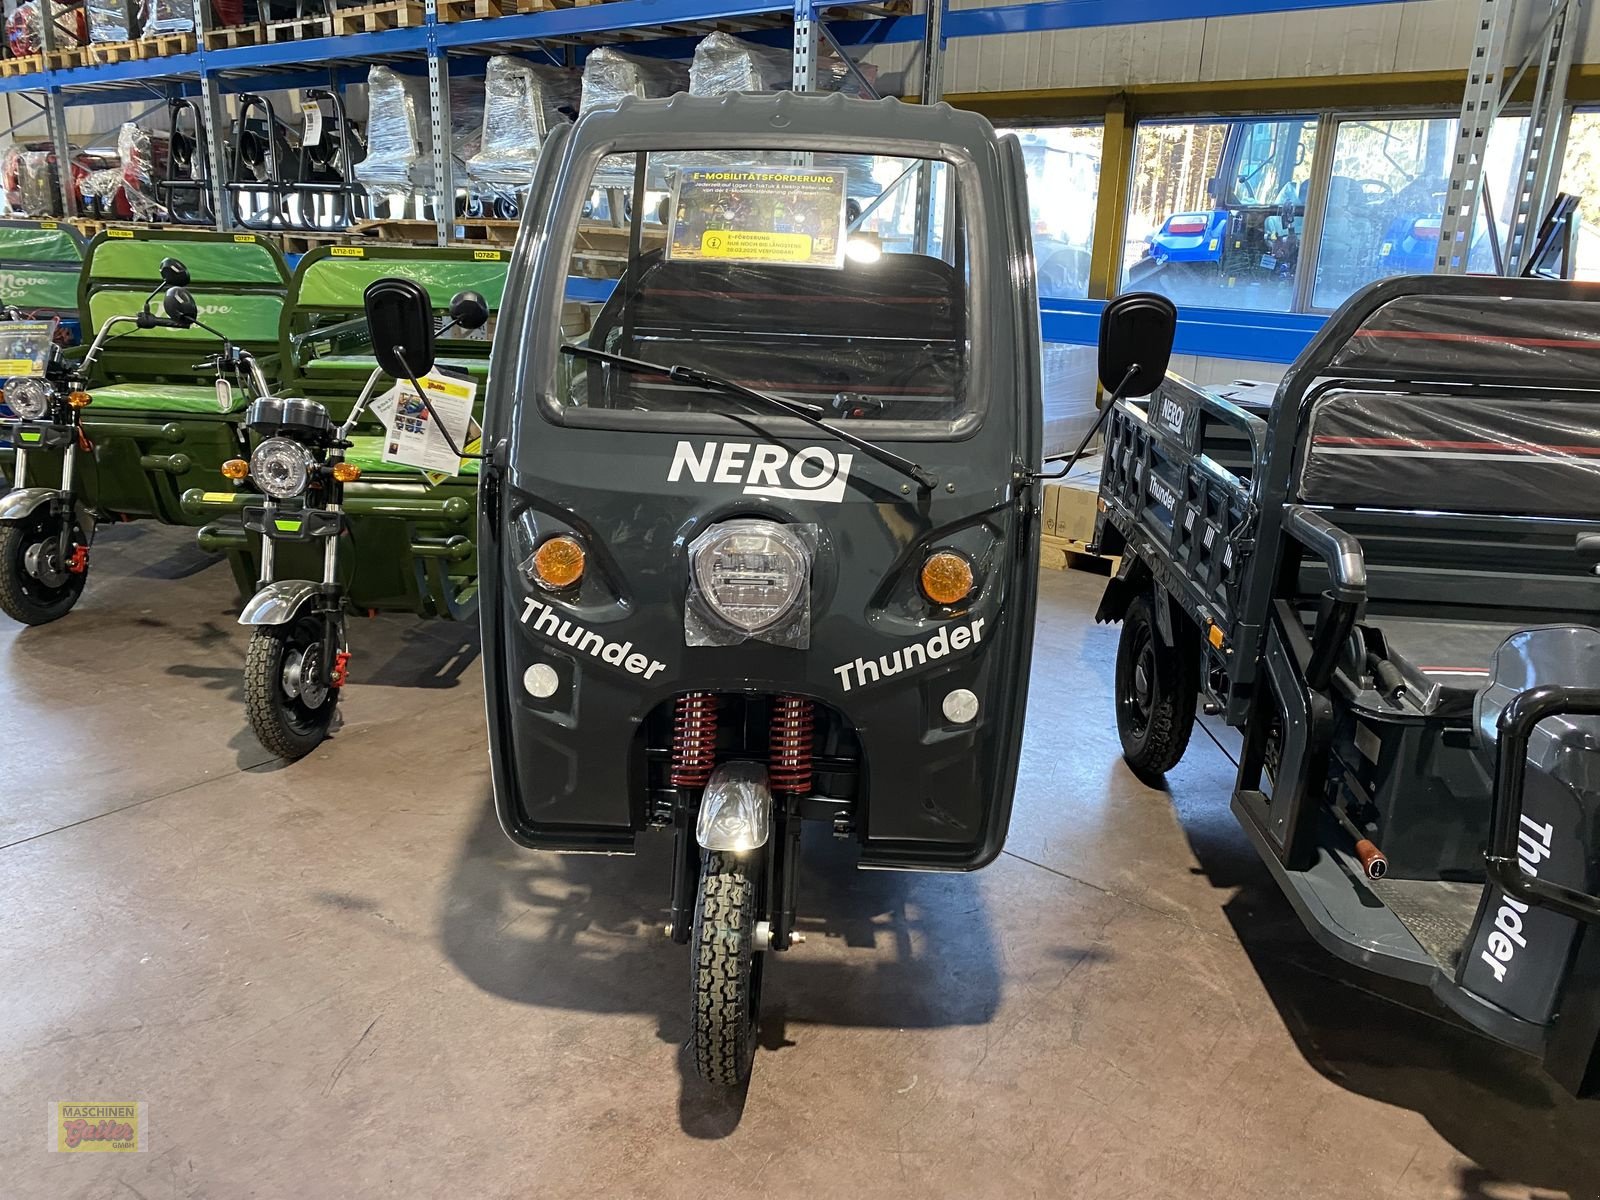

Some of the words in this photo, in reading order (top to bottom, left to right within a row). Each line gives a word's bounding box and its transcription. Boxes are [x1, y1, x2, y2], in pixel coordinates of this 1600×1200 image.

[693, 172, 834, 183] E-MOBILITÄTSFÖRDERUNG
[1162, 398, 1184, 432] NERO
[667, 441, 847, 496] NERO
[1149, 475, 1175, 511] Thunder
[518, 597, 667, 680] Thunder
[834, 617, 985, 691] Thunder
